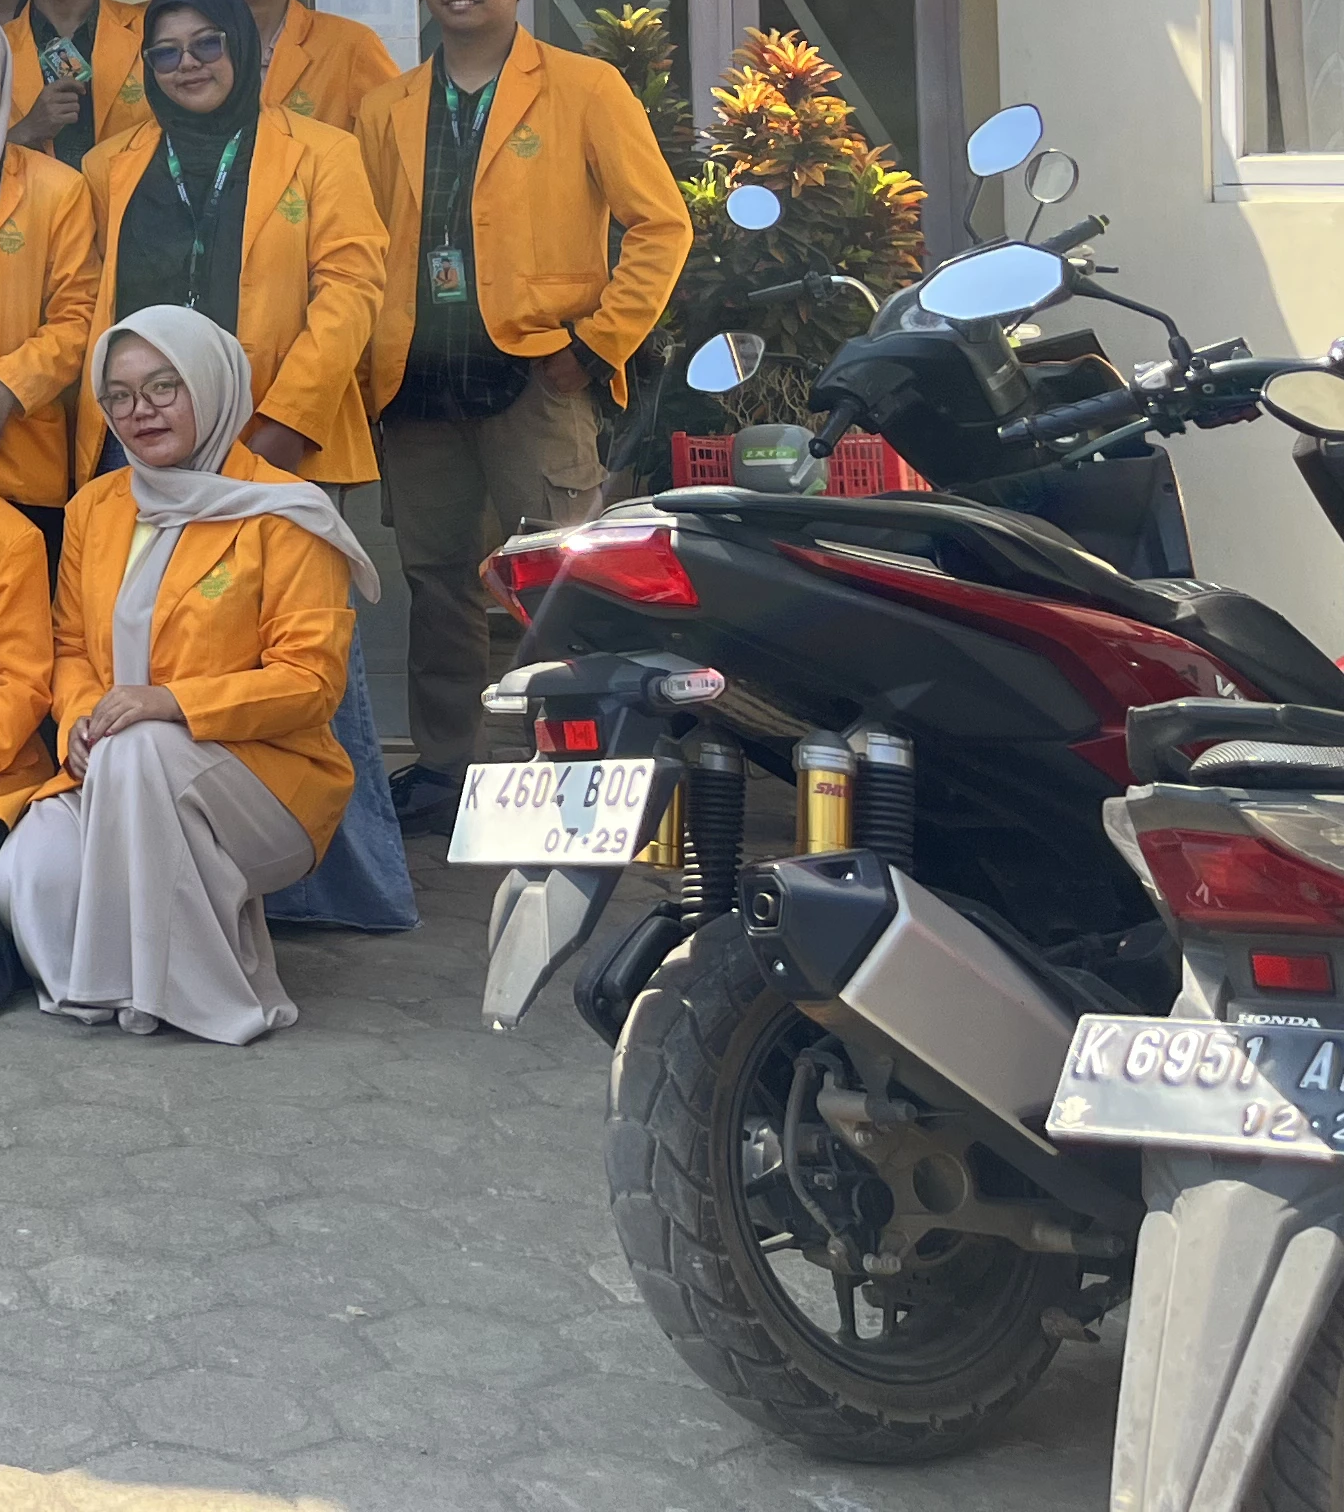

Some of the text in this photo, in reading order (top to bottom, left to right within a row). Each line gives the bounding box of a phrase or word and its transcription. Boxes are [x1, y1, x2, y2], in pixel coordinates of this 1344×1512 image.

[465, 767, 486, 811] K
[496, 765, 573, 809] 4604
[1236, 1013, 1322, 1028] HONDA
[1073, 1024, 1344, 1092] K 6951 A
